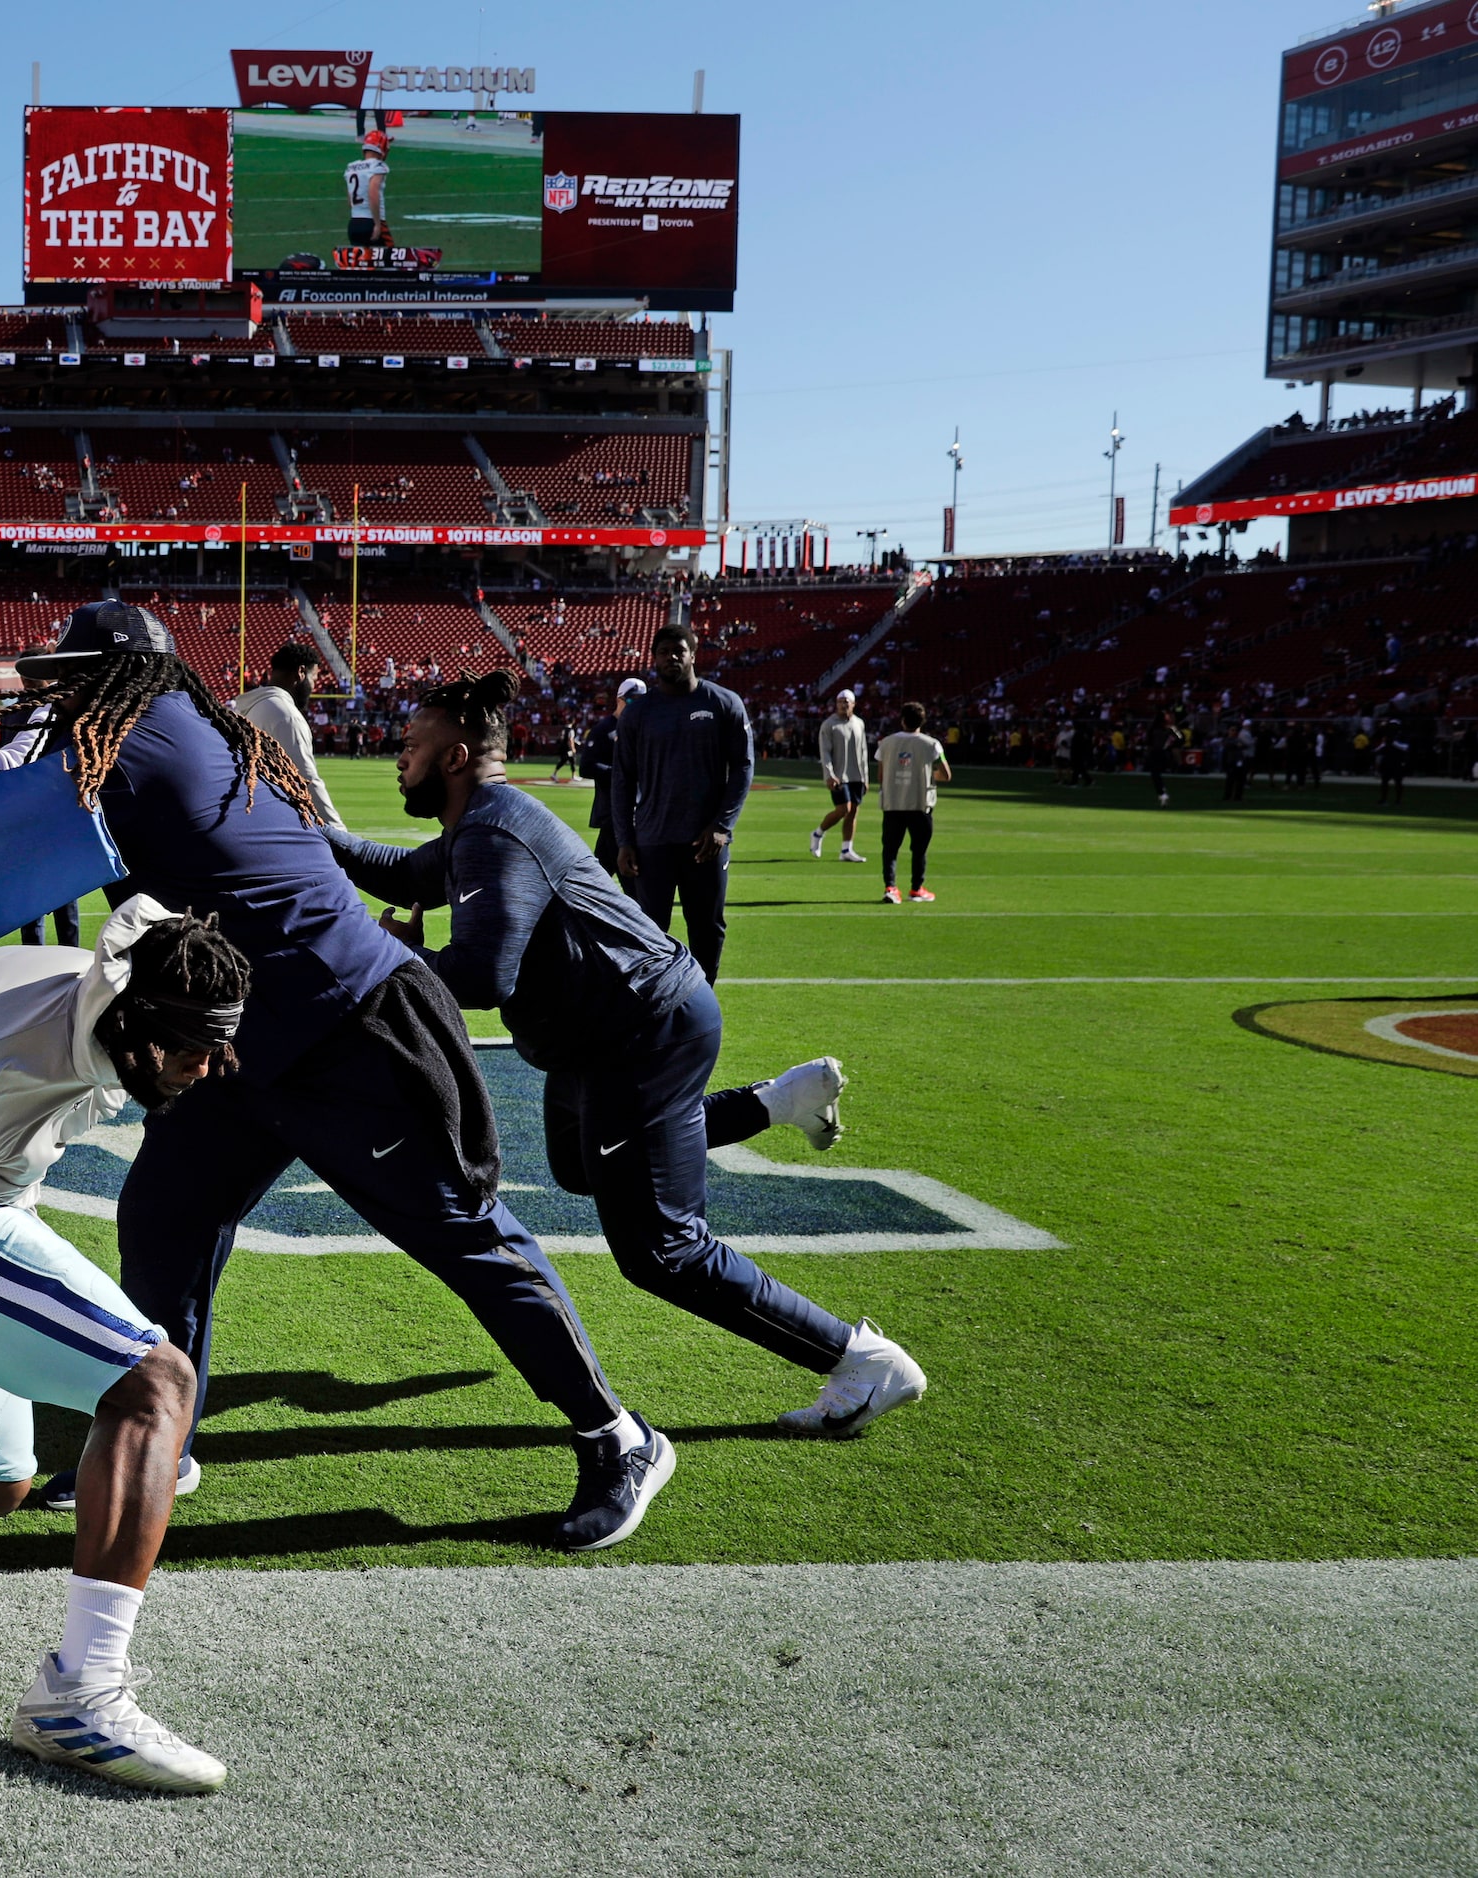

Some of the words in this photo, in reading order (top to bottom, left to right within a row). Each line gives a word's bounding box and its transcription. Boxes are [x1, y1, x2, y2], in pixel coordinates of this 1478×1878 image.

[1420, 22, 1446, 41] 14
[1373, 39, 1396, 57] 12
[380, 65, 536, 94] STADIUM
[1330, 132, 1414, 162] MORABITO
[40, 142, 217, 207] FAITHFUL
[115, 181, 142, 206] to
[349, 174, 364, 204] 2
[548, 190, 573, 207] NFL
[614, 197, 645, 208] NFL
[646, 197, 728, 209] NETWORK
[40, 209, 124, 247] THE
[134, 210, 217, 247] BAY
[588, 217, 632, 226] PRESENTED
[632, 218, 641, 226] BY
[660, 219, 694, 227] TOYOTA
[372, 248, 384, 260] 31
[391, 248, 407, 260] 20
[177, 281, 221, 290] STADIUM
[301, 290, 362, 301] Foxconn
[365, 289, 430, 301] Industrial
[434, 289, 488, 301] Internet
[1393, 478, 1475, 501] STADIUM
[0, 526, 37, 539] 10TH
[37, 527, 96, 540] SEASON
[367, 529, 434, 542] STADIUM
[447, 529, 483, 542] 10TH
[484, 530, 543, 543] SEASON
[293, 544, 310, 558] 40
